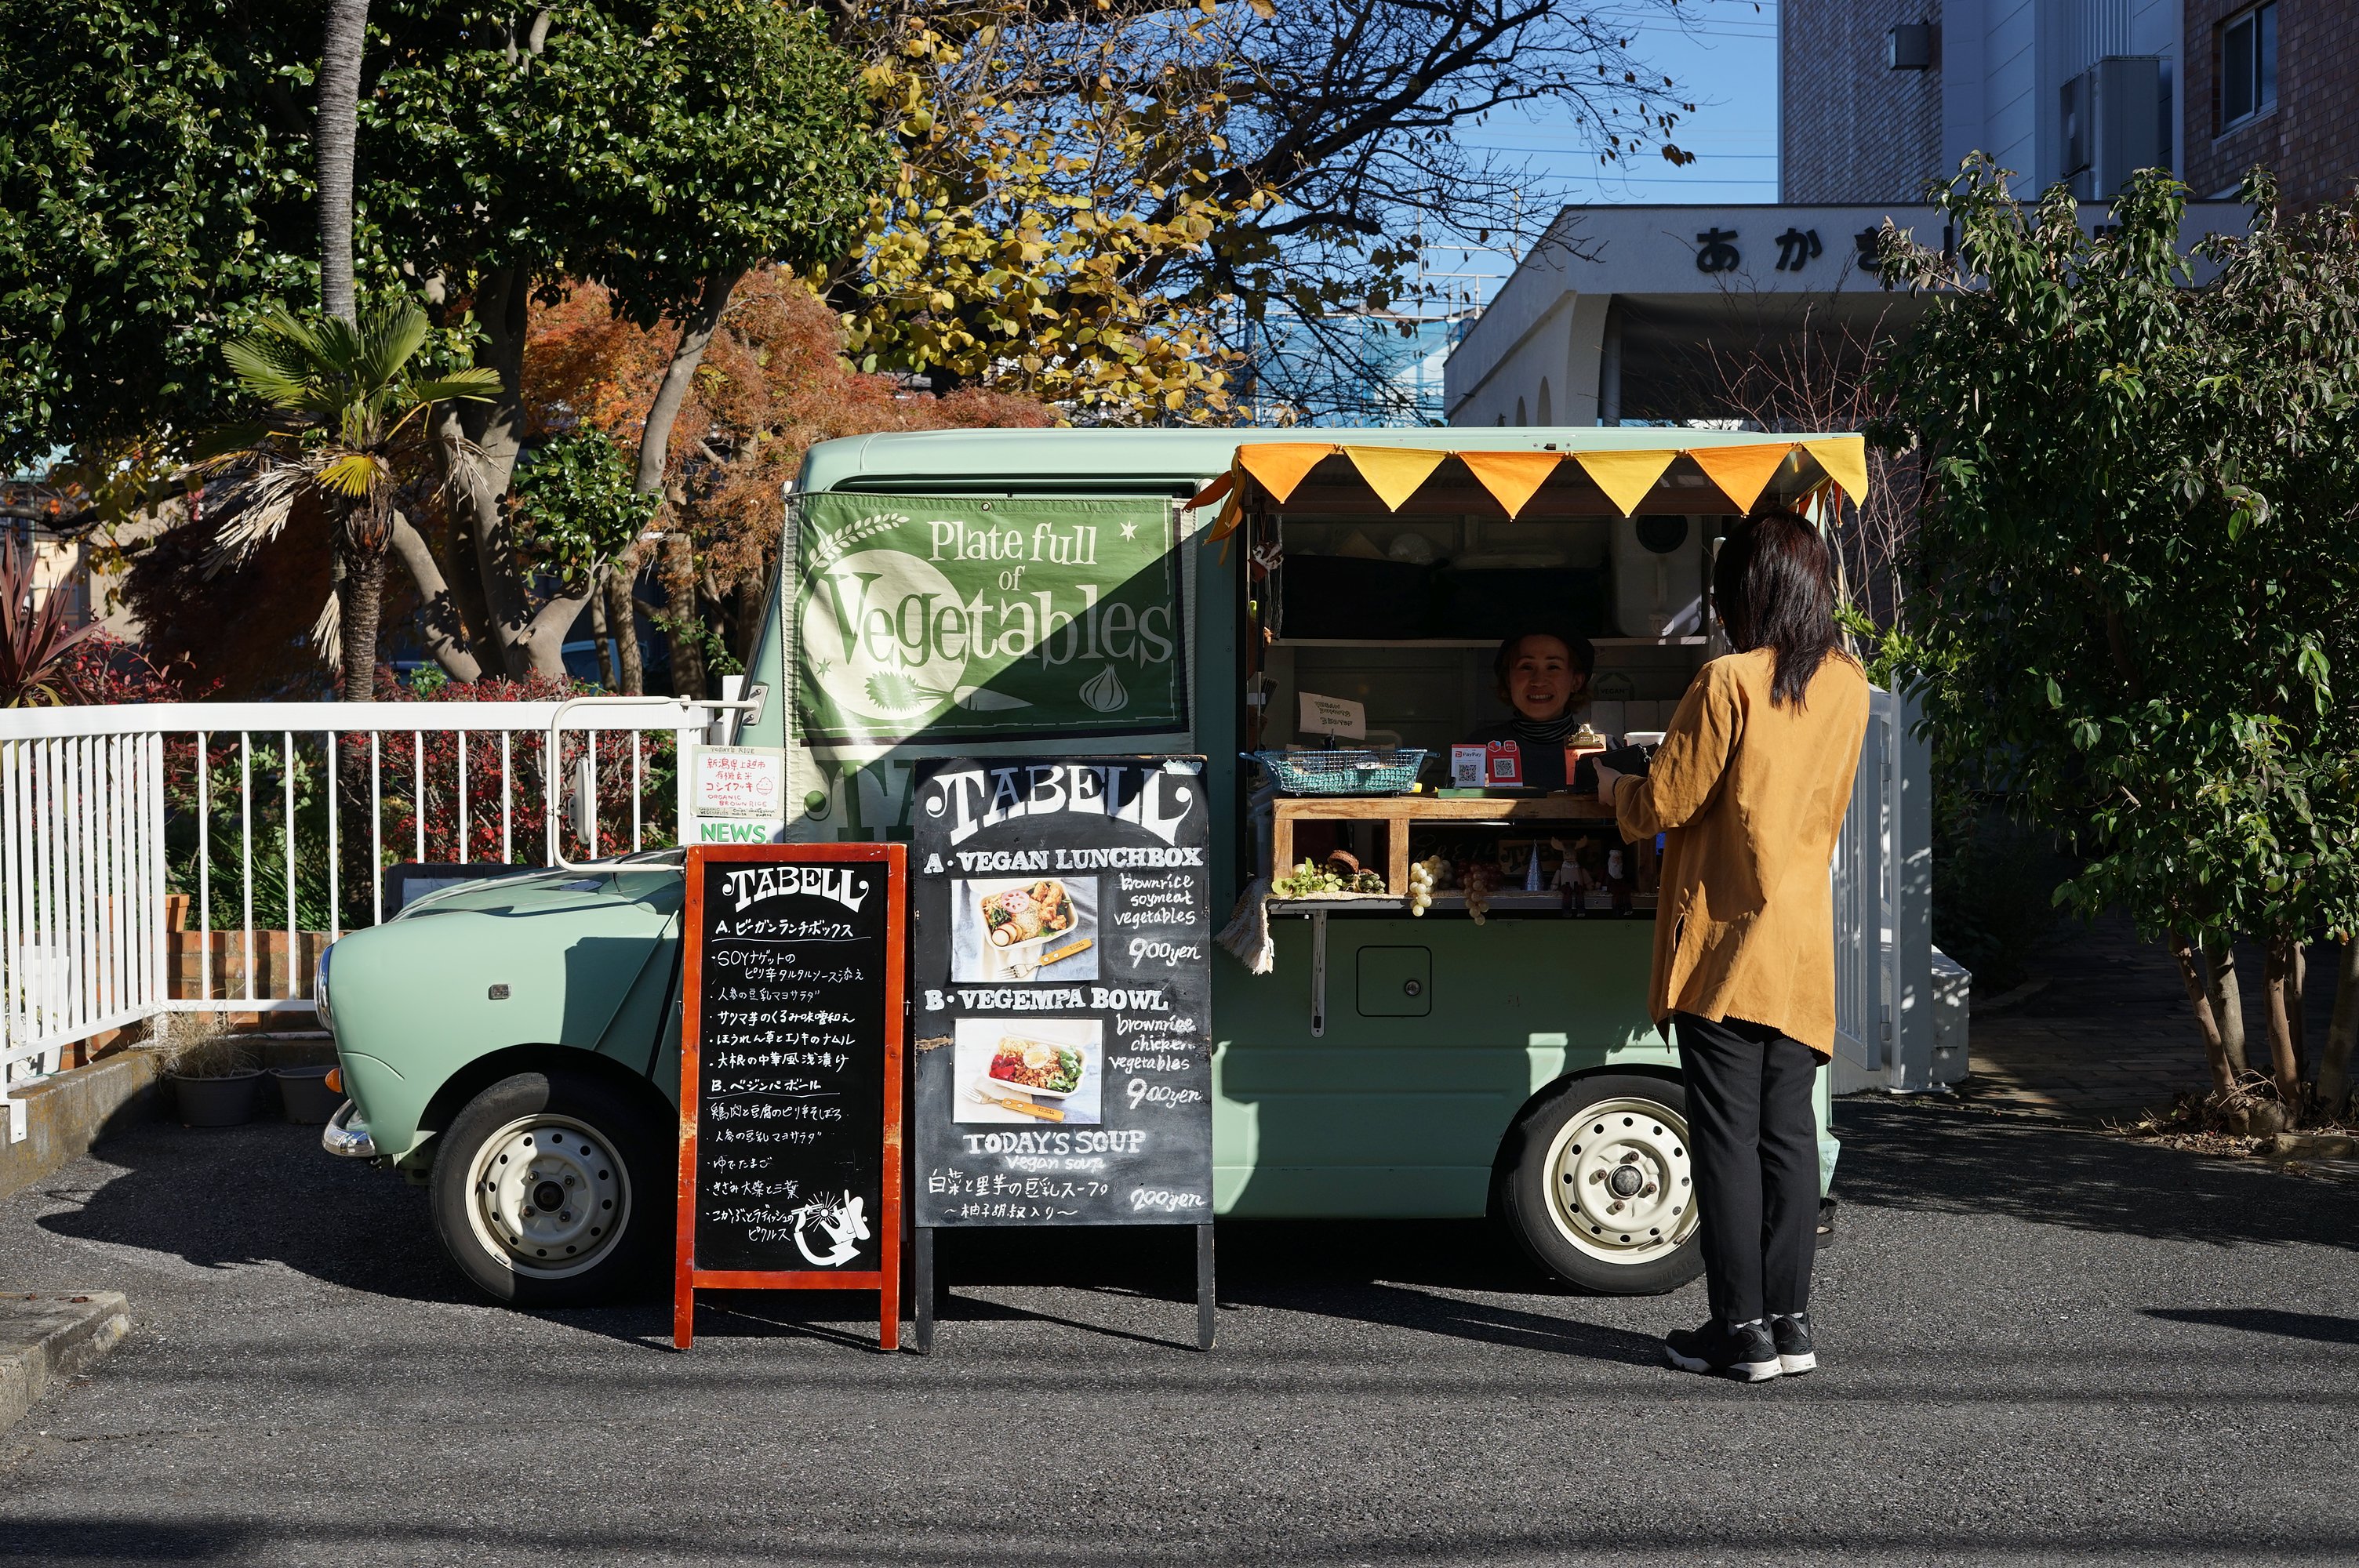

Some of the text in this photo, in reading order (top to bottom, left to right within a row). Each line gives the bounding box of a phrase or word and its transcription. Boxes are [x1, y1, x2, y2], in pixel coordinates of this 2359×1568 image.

[927, 520, 1098, 565] Plate full
[998, 564, 1026, 591] of
[821, 572, 1173, 671] Vegetables
[707, 756, 767, 771] 新潟県上越市
[715, 771, 754, 782] 有機玄米
[926, 764, 1194, 847] TABELL
[956, 849, 1050, 872] VEGAN
[1055, 847, 1204, 870] LUNCHBOX
[722, 866, 870, 913] TABELL
[736, 919, 854, 938] ビーガンランチボックス
[1114, 907, 1197, 930] vegetables
[1129, 937, 1202, 969] 900yen
[745, 967, 864, 983] ピリ辛タルタルソース添え
[957, 989, 1087, 1011] VEGEMPA
[1090, 987, 1169, 1011] BOWL
[716, 1031, 856, 1046] ほうれん草とエノキのナムル
[718, 1051, 849, 1073] 大根の中華風浅漬け
[1109, 1054, 1190, 1074] vegetables
[1127, 1078, 1203, 1110] 900yen
[962, 1129, 1147, 1155] TODAY'S SOUP
[713, 1155, 772, 1174] ゆでたまご
[1005, 1155, 1107, 1174] vegan soup
[713, 1179, 800, 1200] きざみ大葉と三葉
[928, 1168, 1109, 1199] 白菜と里芋の豆乳スープ
[1130, 1189, 1206, 1212] 200yen
[748, 1227, 791, 1243] ピクルス
